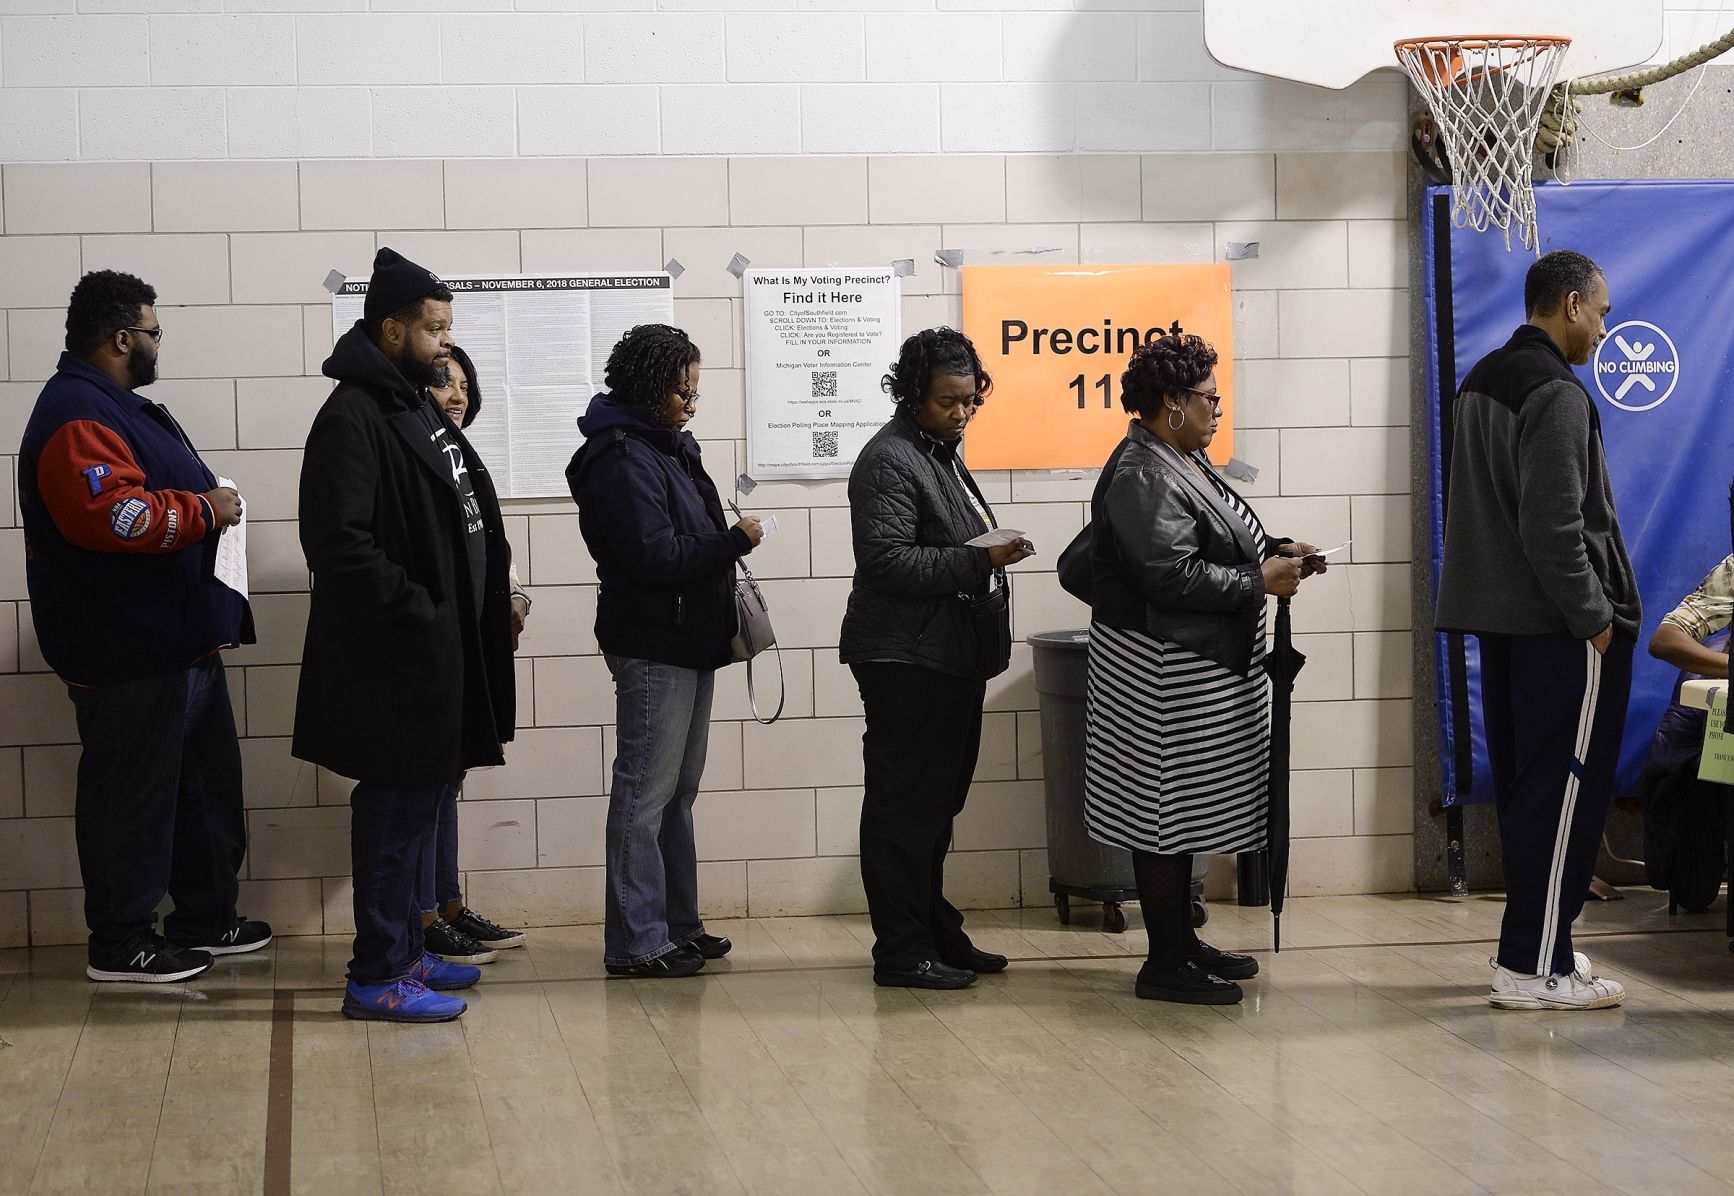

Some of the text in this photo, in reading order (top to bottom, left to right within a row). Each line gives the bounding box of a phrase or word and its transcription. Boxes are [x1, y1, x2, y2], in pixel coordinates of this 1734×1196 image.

[481, 280, 534, 289] NOVEMBER
[536, 280, 544, 289] 6,
[546, 279, 567, 288] 2018
[569, 279, 612, 288] GENERAL
[615, 278, 660, 287] ELECTION
[753, 275, 891, 287] What Is My Voting Precinct?
[783, 292, 862, 304] Find it Here
[863, 316, 881, 324] Voting
[1598, 361, 1675, 374] NO CLIMBING
[1068, 373, 1112, 409] 11
[830, 421, 855, 429] Mapping
[114, 498, 147, 537] EASTERN
[160, 509, 178, 548] PISTONS
[1711, 708, 1726, 717] PLEAS
